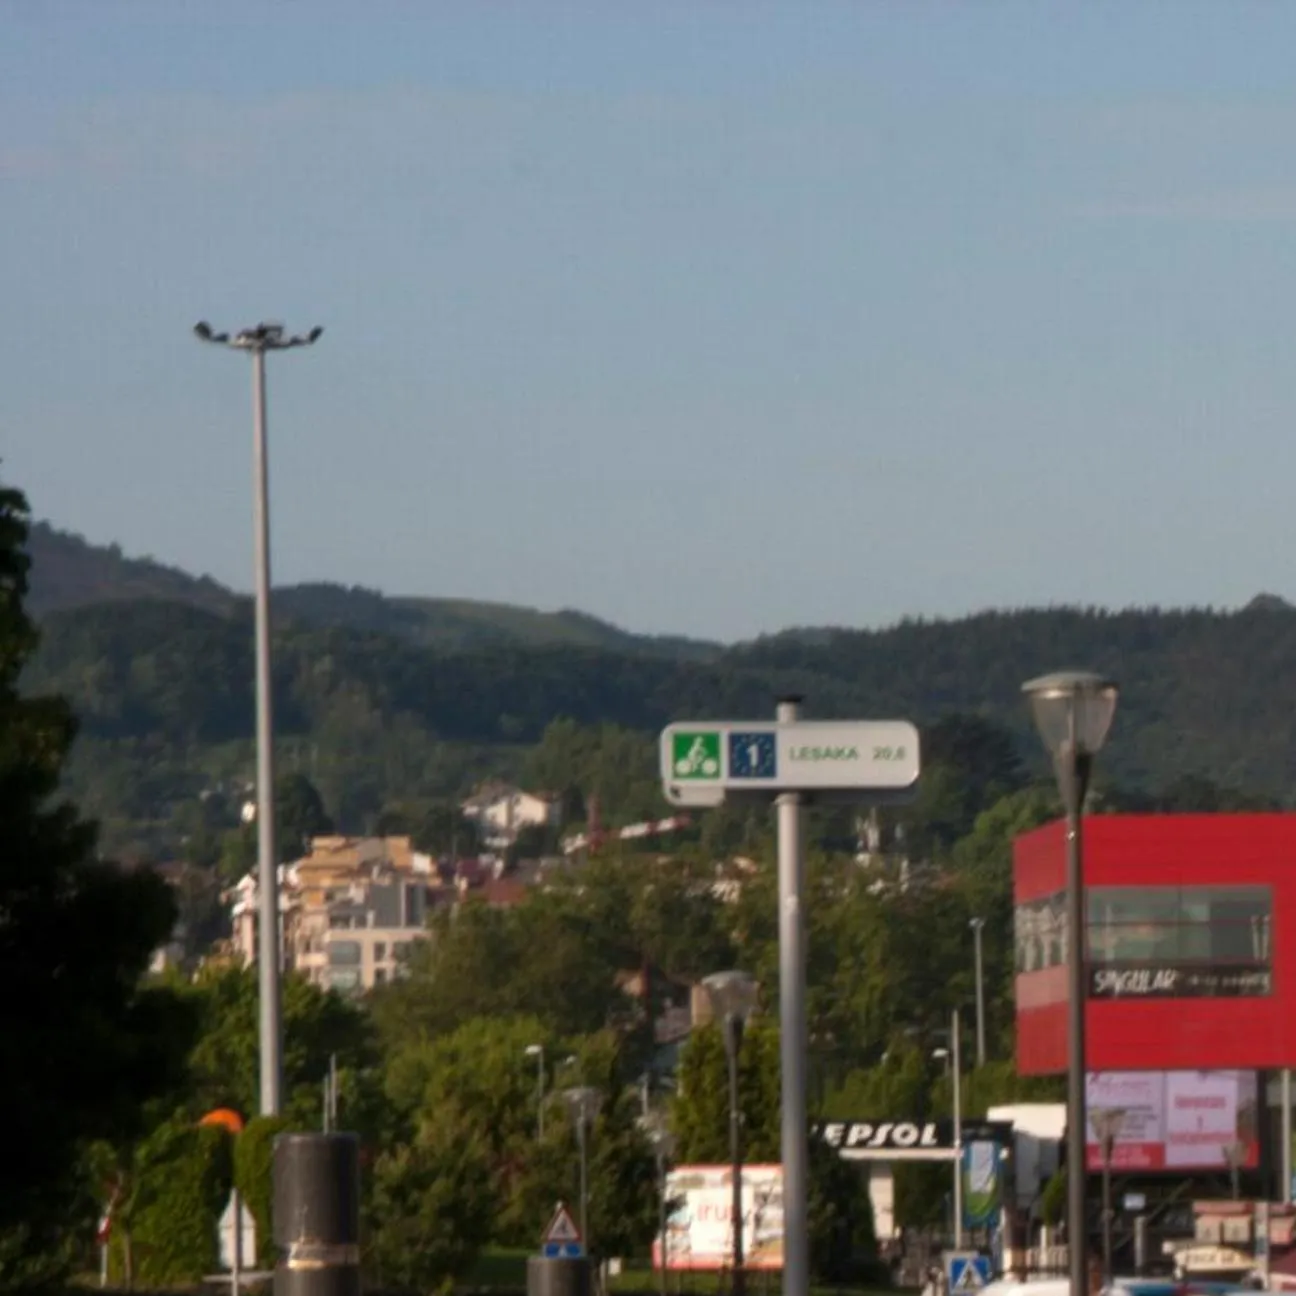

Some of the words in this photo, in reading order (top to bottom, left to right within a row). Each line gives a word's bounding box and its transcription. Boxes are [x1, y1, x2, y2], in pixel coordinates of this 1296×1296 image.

[747, 744, 759, 768] 1
[789, 745, 858, 761] LESAKA
[811, 1122, 936, 1147] EPSOL
